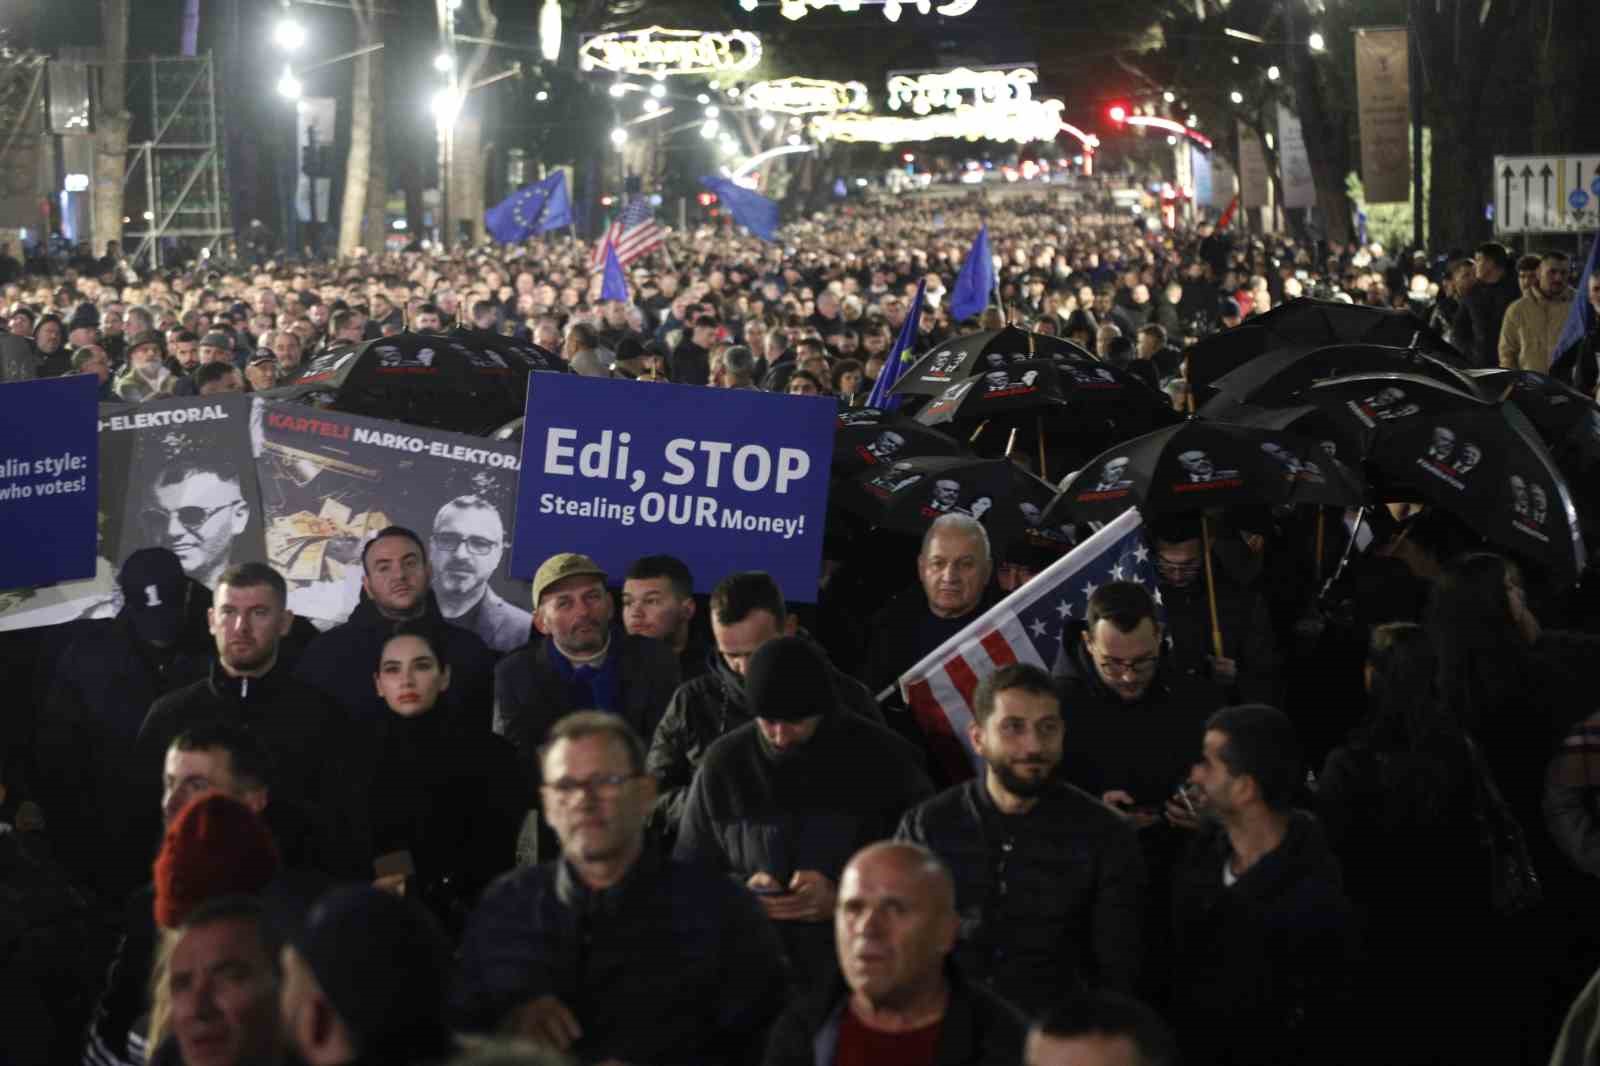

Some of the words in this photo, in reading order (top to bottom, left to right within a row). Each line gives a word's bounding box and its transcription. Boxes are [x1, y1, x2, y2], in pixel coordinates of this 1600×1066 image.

[267, 414, 352, 439] KARTELI
[34, 452, 87, 477] style:
[543, 427, 647, 492] Edi,
[661, 438, 811, 494] STOP
[0, 483, 32, 500] who
[35, 475, 86, 496] votes!
[539, 493, 636, 525] Stealing
[639, 492, 718, 528] OUR
[720, 508, 805, 539] Money!
[144, 584, 162, 607] 1
